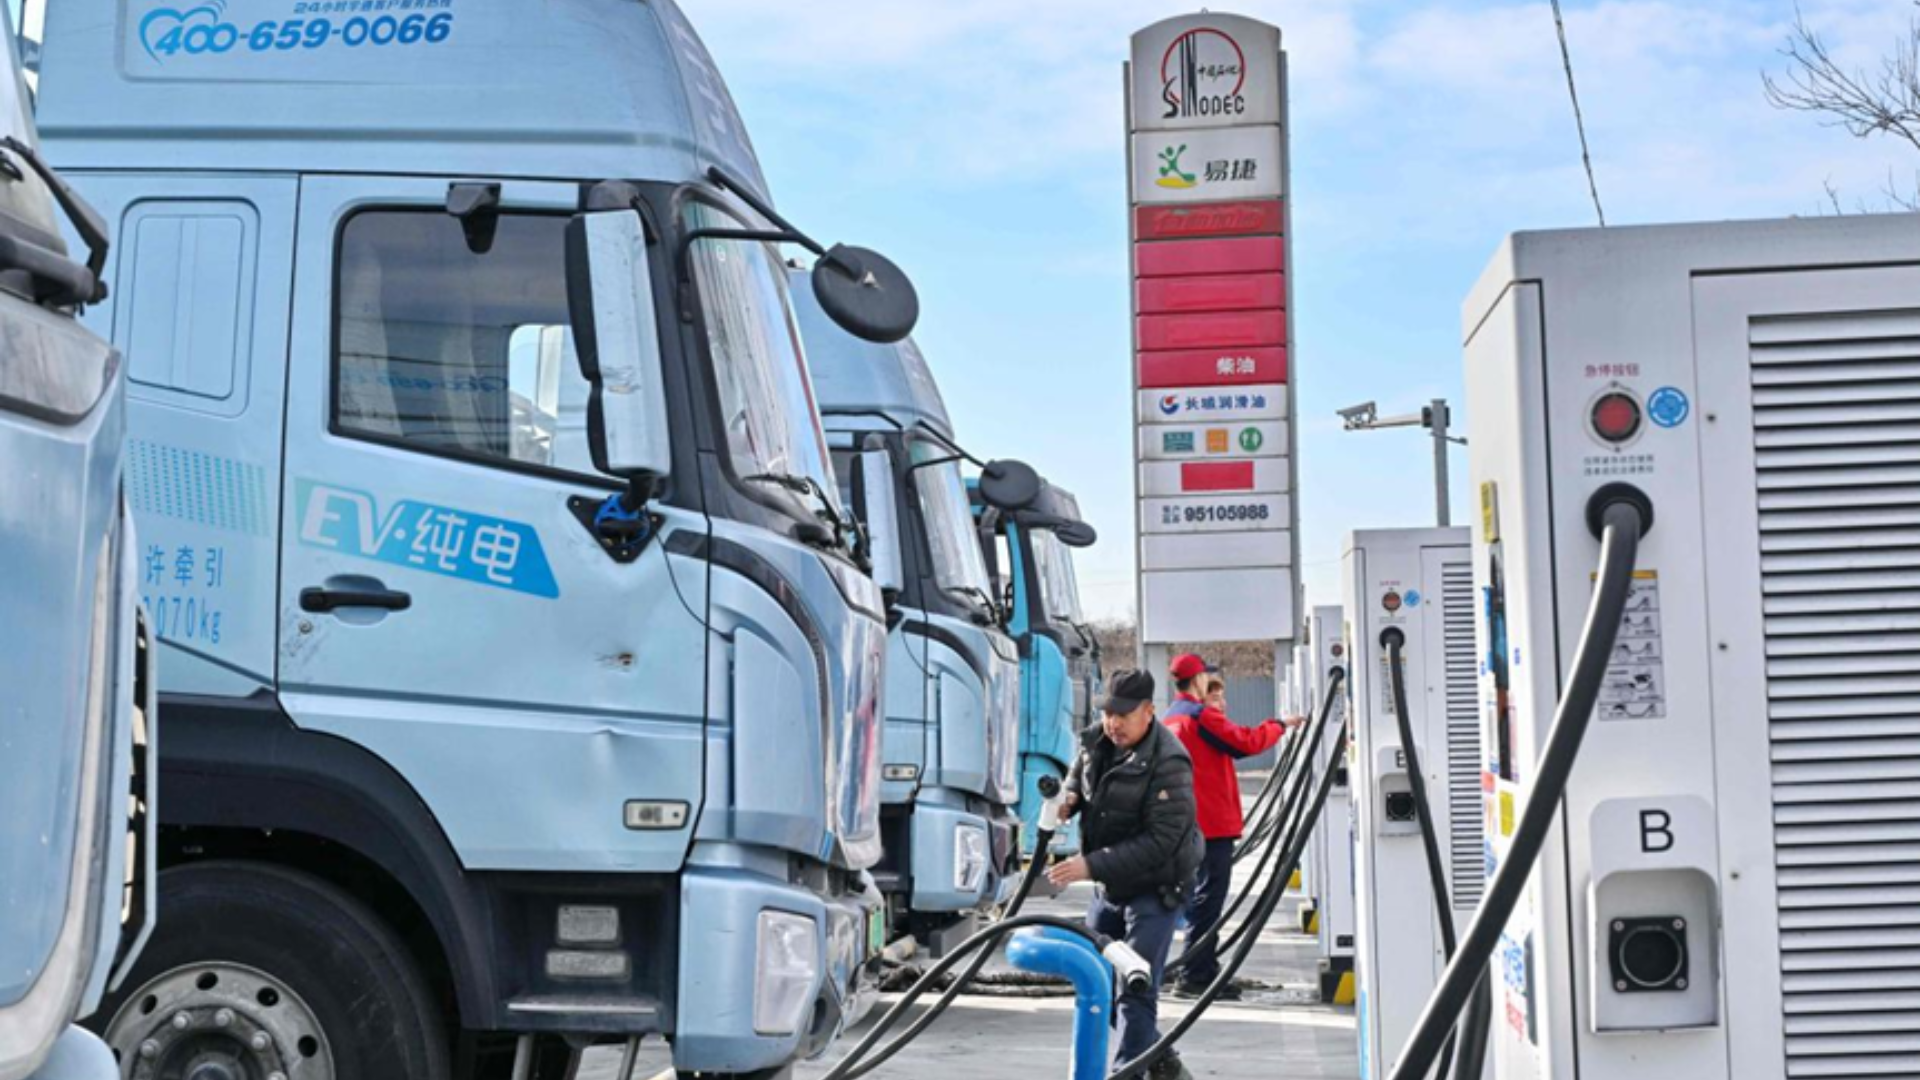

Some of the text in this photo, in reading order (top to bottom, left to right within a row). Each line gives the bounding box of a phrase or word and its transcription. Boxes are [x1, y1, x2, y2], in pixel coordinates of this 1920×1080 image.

[154, 13, 453, 54] 400-659-0066
[1204, 159, 1257, 181] 易捷
[1216, 356, 1256, 375] 柴油
[1185, 394, 1266, 411] 长城润滑油
[1184, 504, 1269, 522] 95105988
[1639, 809, 1674, 853] B
